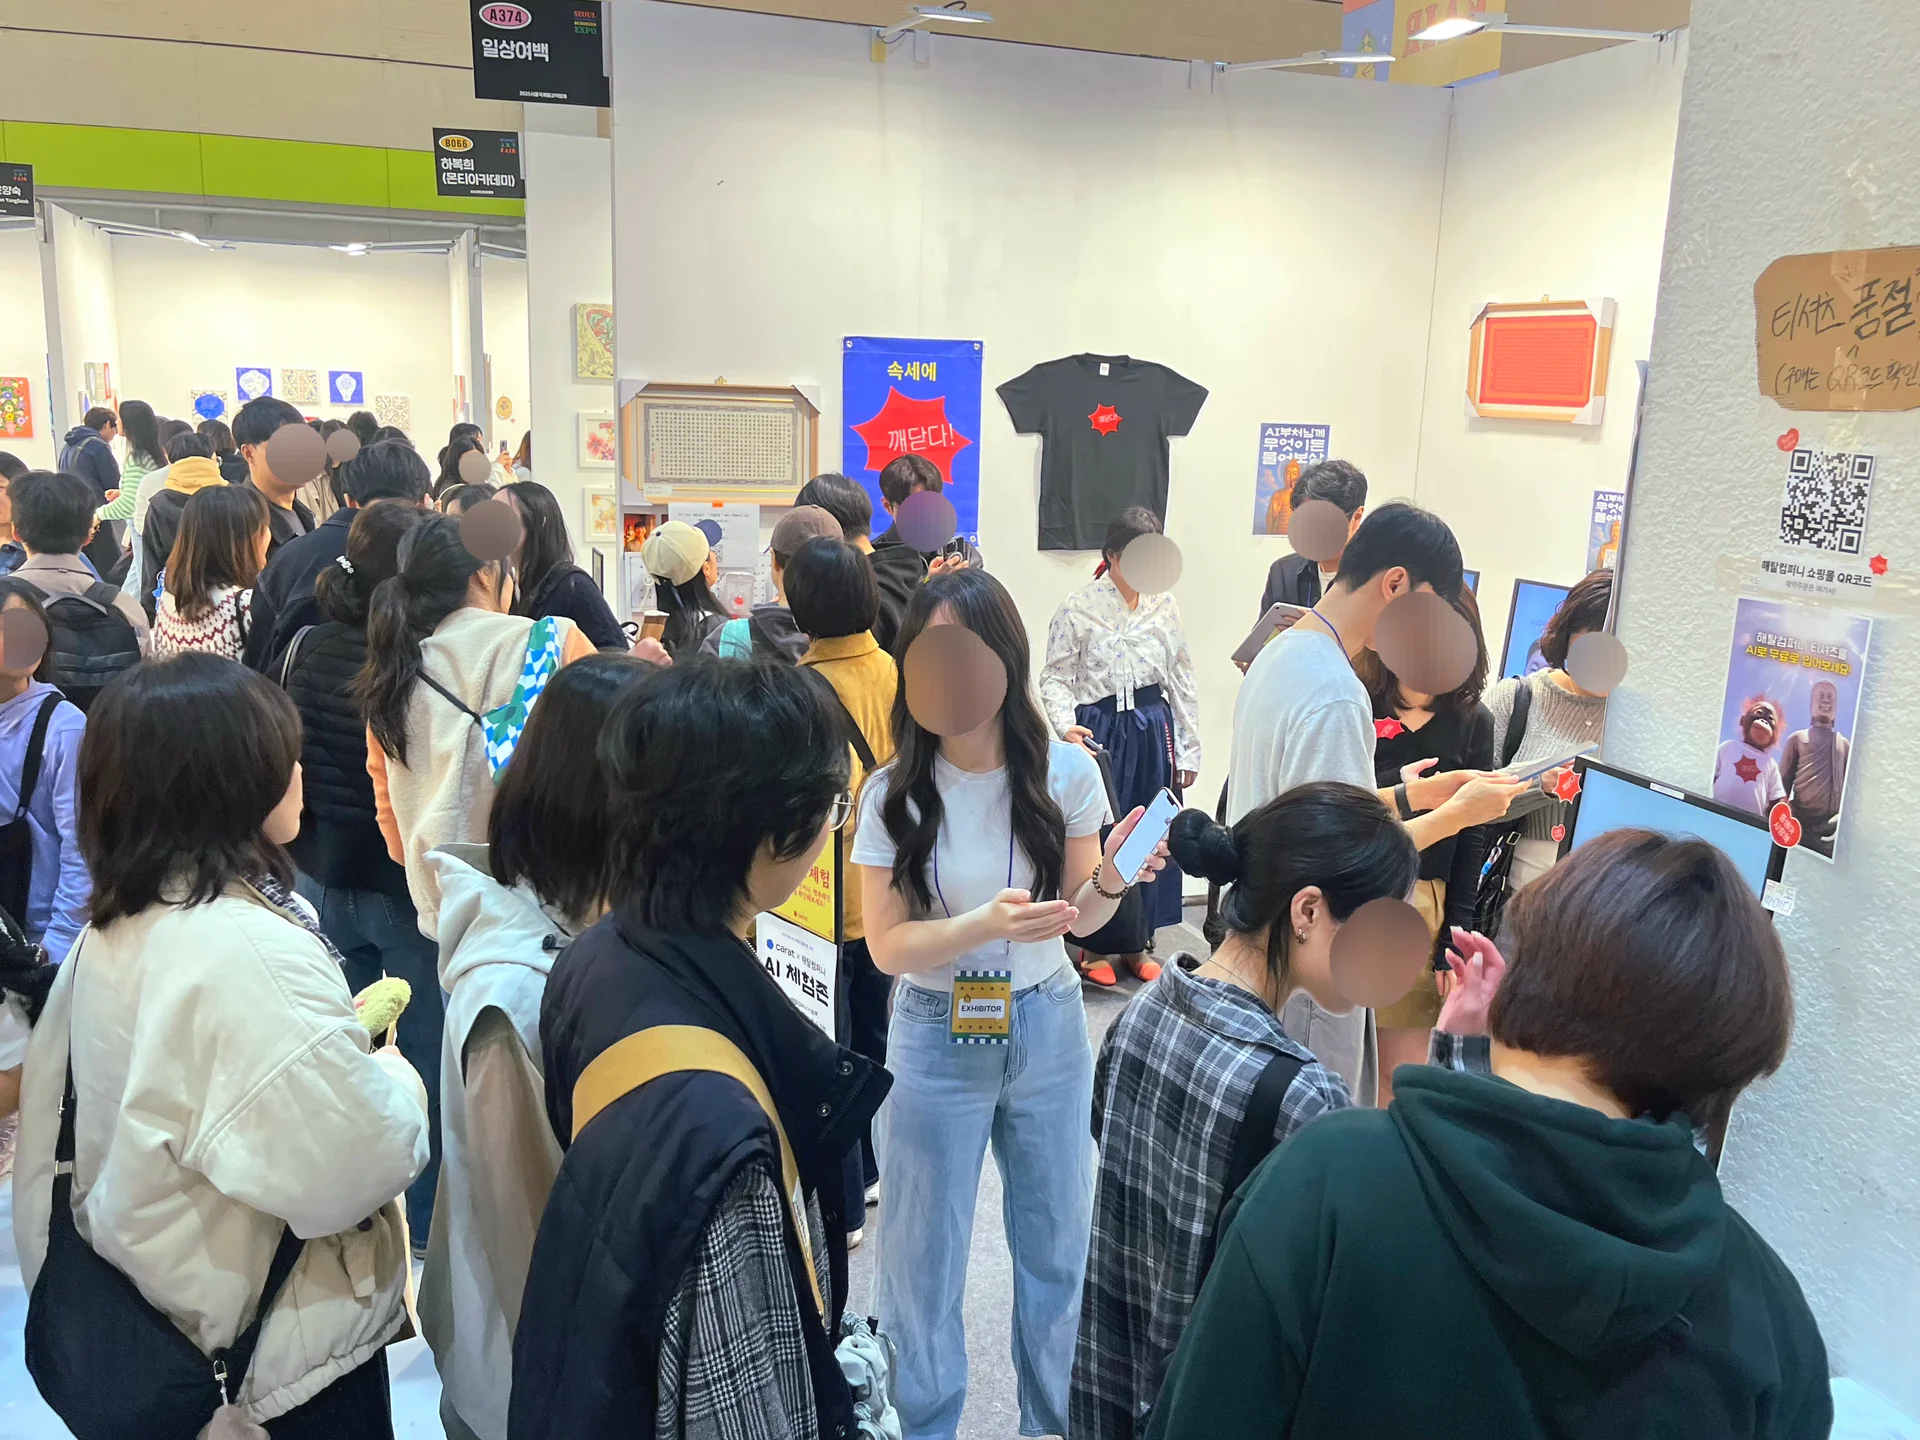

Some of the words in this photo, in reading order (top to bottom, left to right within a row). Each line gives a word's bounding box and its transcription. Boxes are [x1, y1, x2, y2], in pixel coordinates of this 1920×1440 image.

[489, 8, 523, 24] A374
[573, 10, 597, 18] SEOUL
[574, 26, 597, 35] EXPO
[481, 38, 550, 62] 일상여백
[445, 138, 468, 148] B066
[440, 157, 475, 171] 하복희
[442, 171, 516, 187] (몬티아카데미)
[0, 185, 21, 197] 양숙
[1771, 292, 1846, 341] 티셔츠
[1849, 277, 1916, 340] 품절
[887, 361, 937, 382] 속세에
[1775, 362, 1820, 395] (구매는
[887, 422, 955, 452] 깨닫다!
[1264, 427, 1326, 438] AI부처님께
[1263, 437, 1326, 452] 무엇이든
[1761, 560, 1806, 578] 해탈컴퍼니
[1806, 567, 1836, 583] 쇼핑몰
[1837, 572, 1873, 588] QR코드
[1756, 631, 1808, 651] 해탈컴퍼니
[1745, 644, 1768, 658] AI로
[1769, 648, 1800, 664] 무료로
[775, 942, 796, 959] carat
[765, 956, 781, 978] AI
[786, 963, 830, 1008] 체험존
[961, 1004, 1002, 1013] EXHIBITOR
